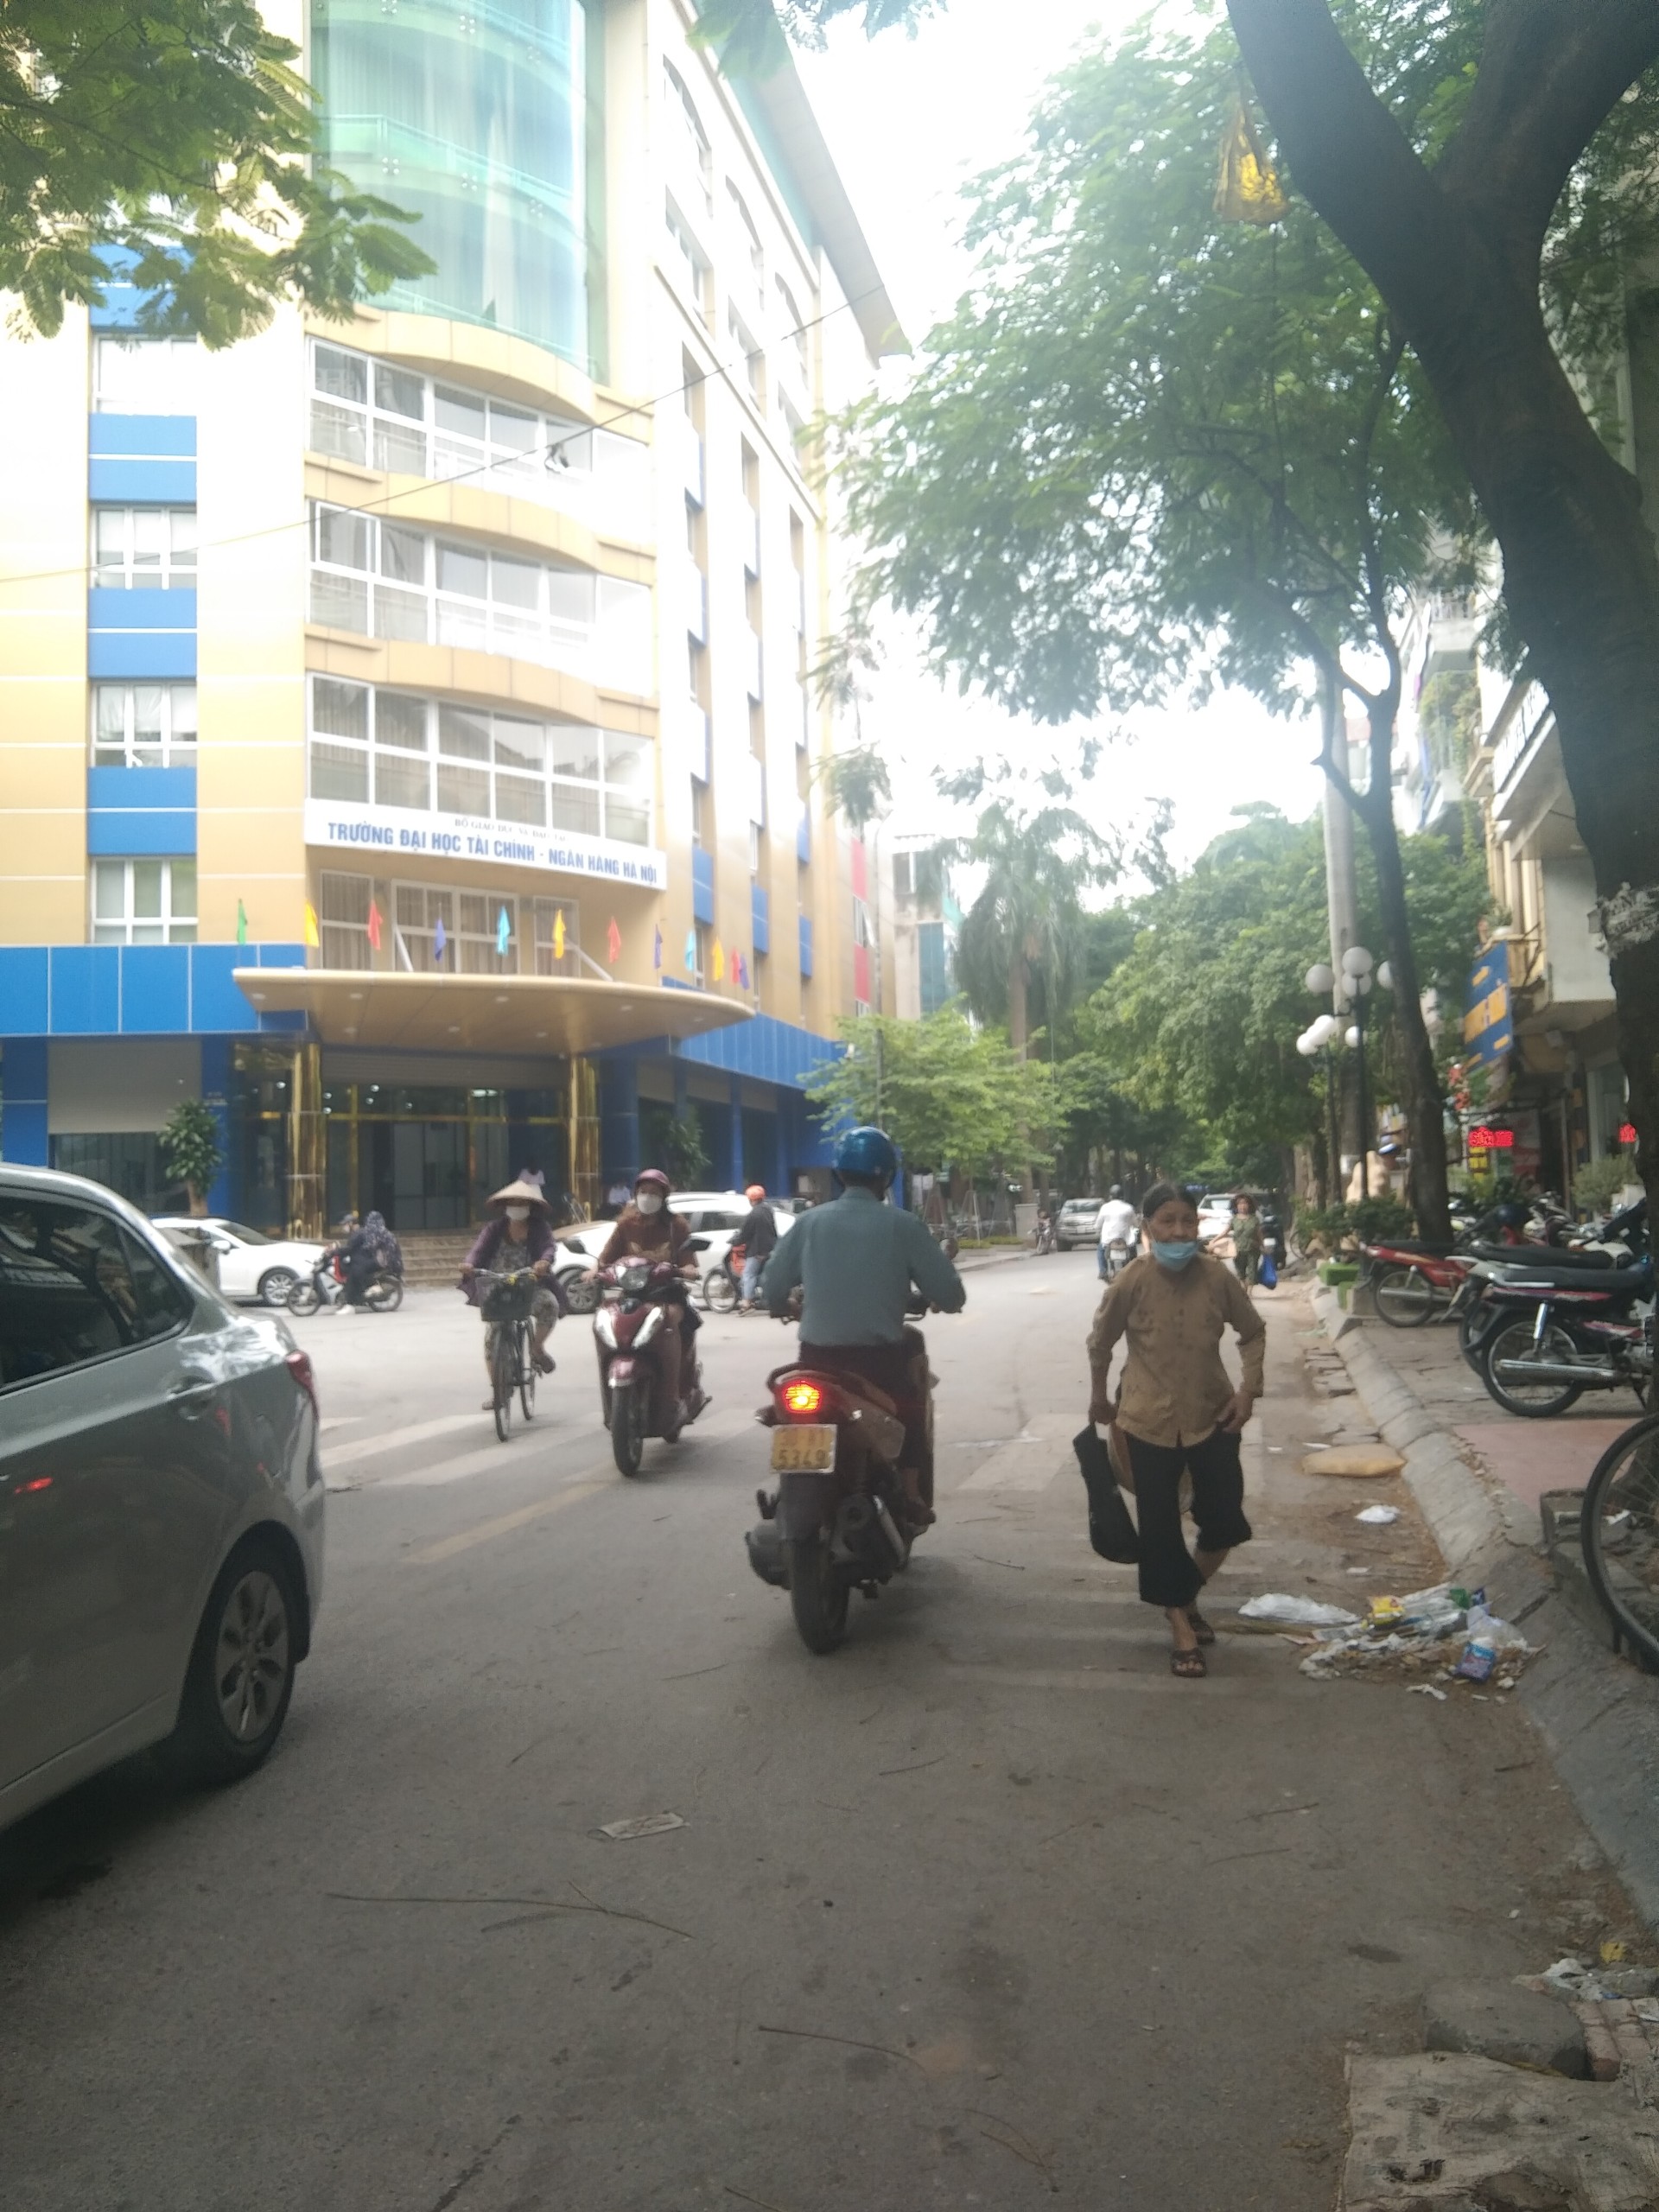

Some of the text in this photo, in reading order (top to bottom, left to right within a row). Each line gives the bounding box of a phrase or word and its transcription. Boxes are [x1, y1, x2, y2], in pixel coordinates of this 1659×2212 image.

[328, 822, 393, 845] TRƯỜNG
[400, 829, 426, 852] ĐẠI
[431, 832, 461, 855] HỌC
[467, 834, 489, 855] TÀI
[493, 838, 536, 861] CHÍNH
[549, 847, 584, 869] NGÂN
[588, 855, 620, 876] HÀNG
[623, 861, 638, 879] HÀ
[640, 864, 657, 886] NỘI
